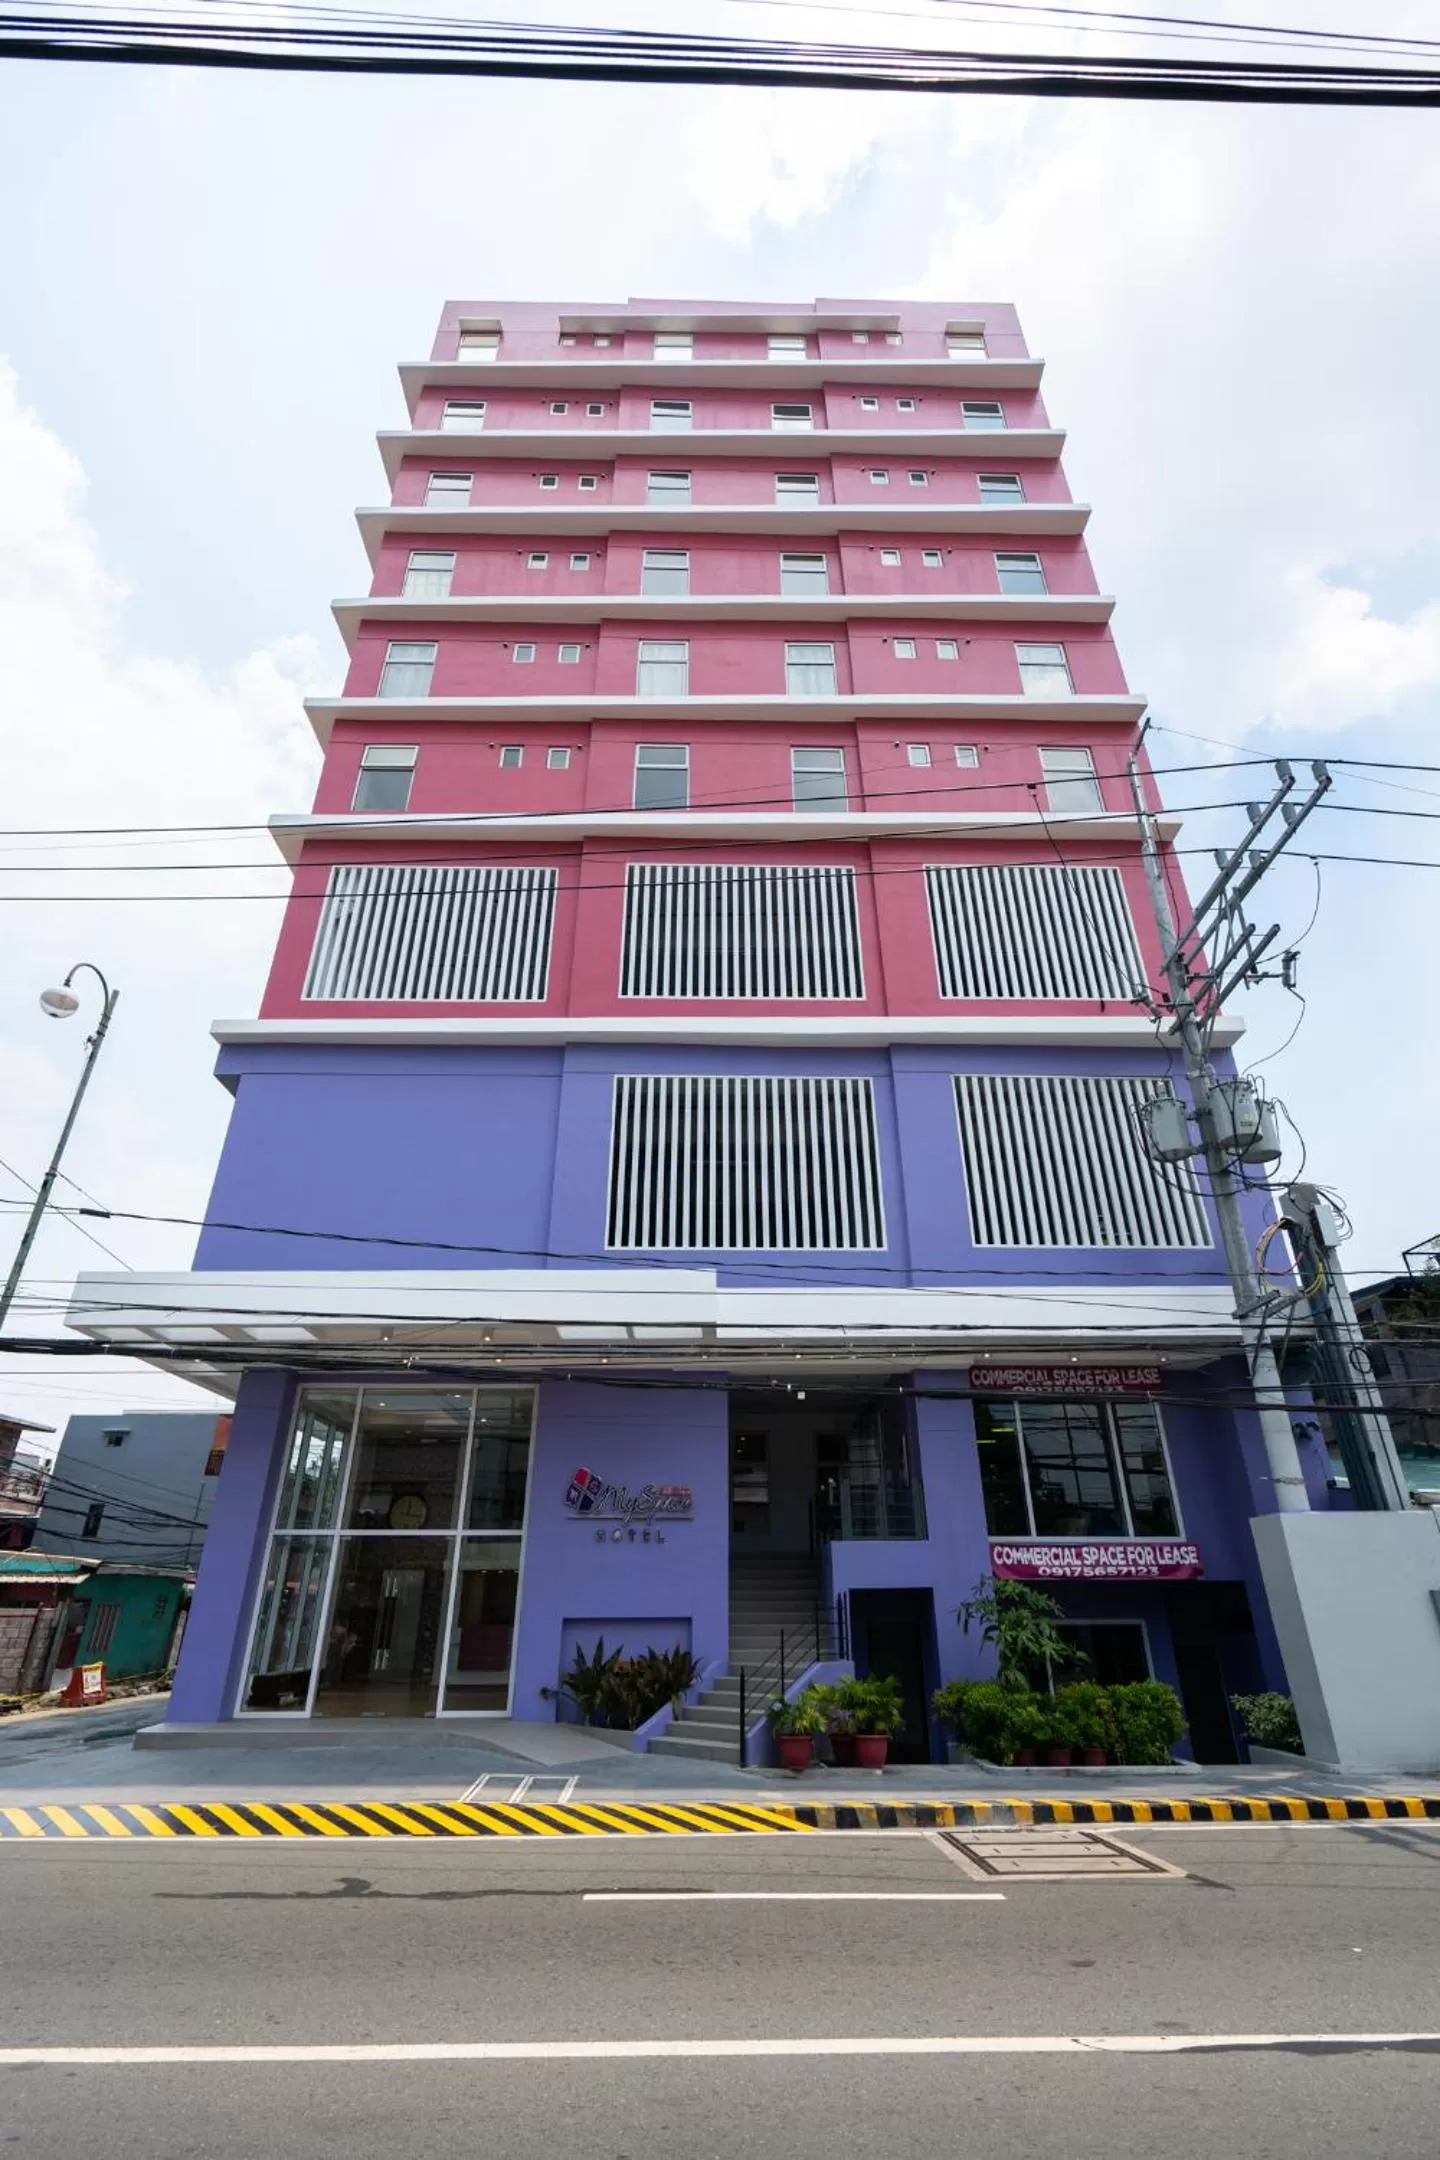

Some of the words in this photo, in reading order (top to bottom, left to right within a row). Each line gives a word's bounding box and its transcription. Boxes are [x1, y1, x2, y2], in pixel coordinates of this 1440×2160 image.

[971, 1368, 1051, 1386] COMMERCIAL
[1053, 1368, 1094, 1386] SPACE
[1094, 1368, 1121, 1385] FOR
[1121, 1367, 1161, 1384] LEASE
[595, 1528, 665, 1545] HOTEL
[993, 1545, 1082, 1566] COMMERCIAL
[1082, 1545, 1127, 1566] SPACE
[1126, 1545, 1156, 1565] FOR
[1156, 1545, 1199, 1564] LEASE
[1037, 1566, 1160, 1577] 09175657123
